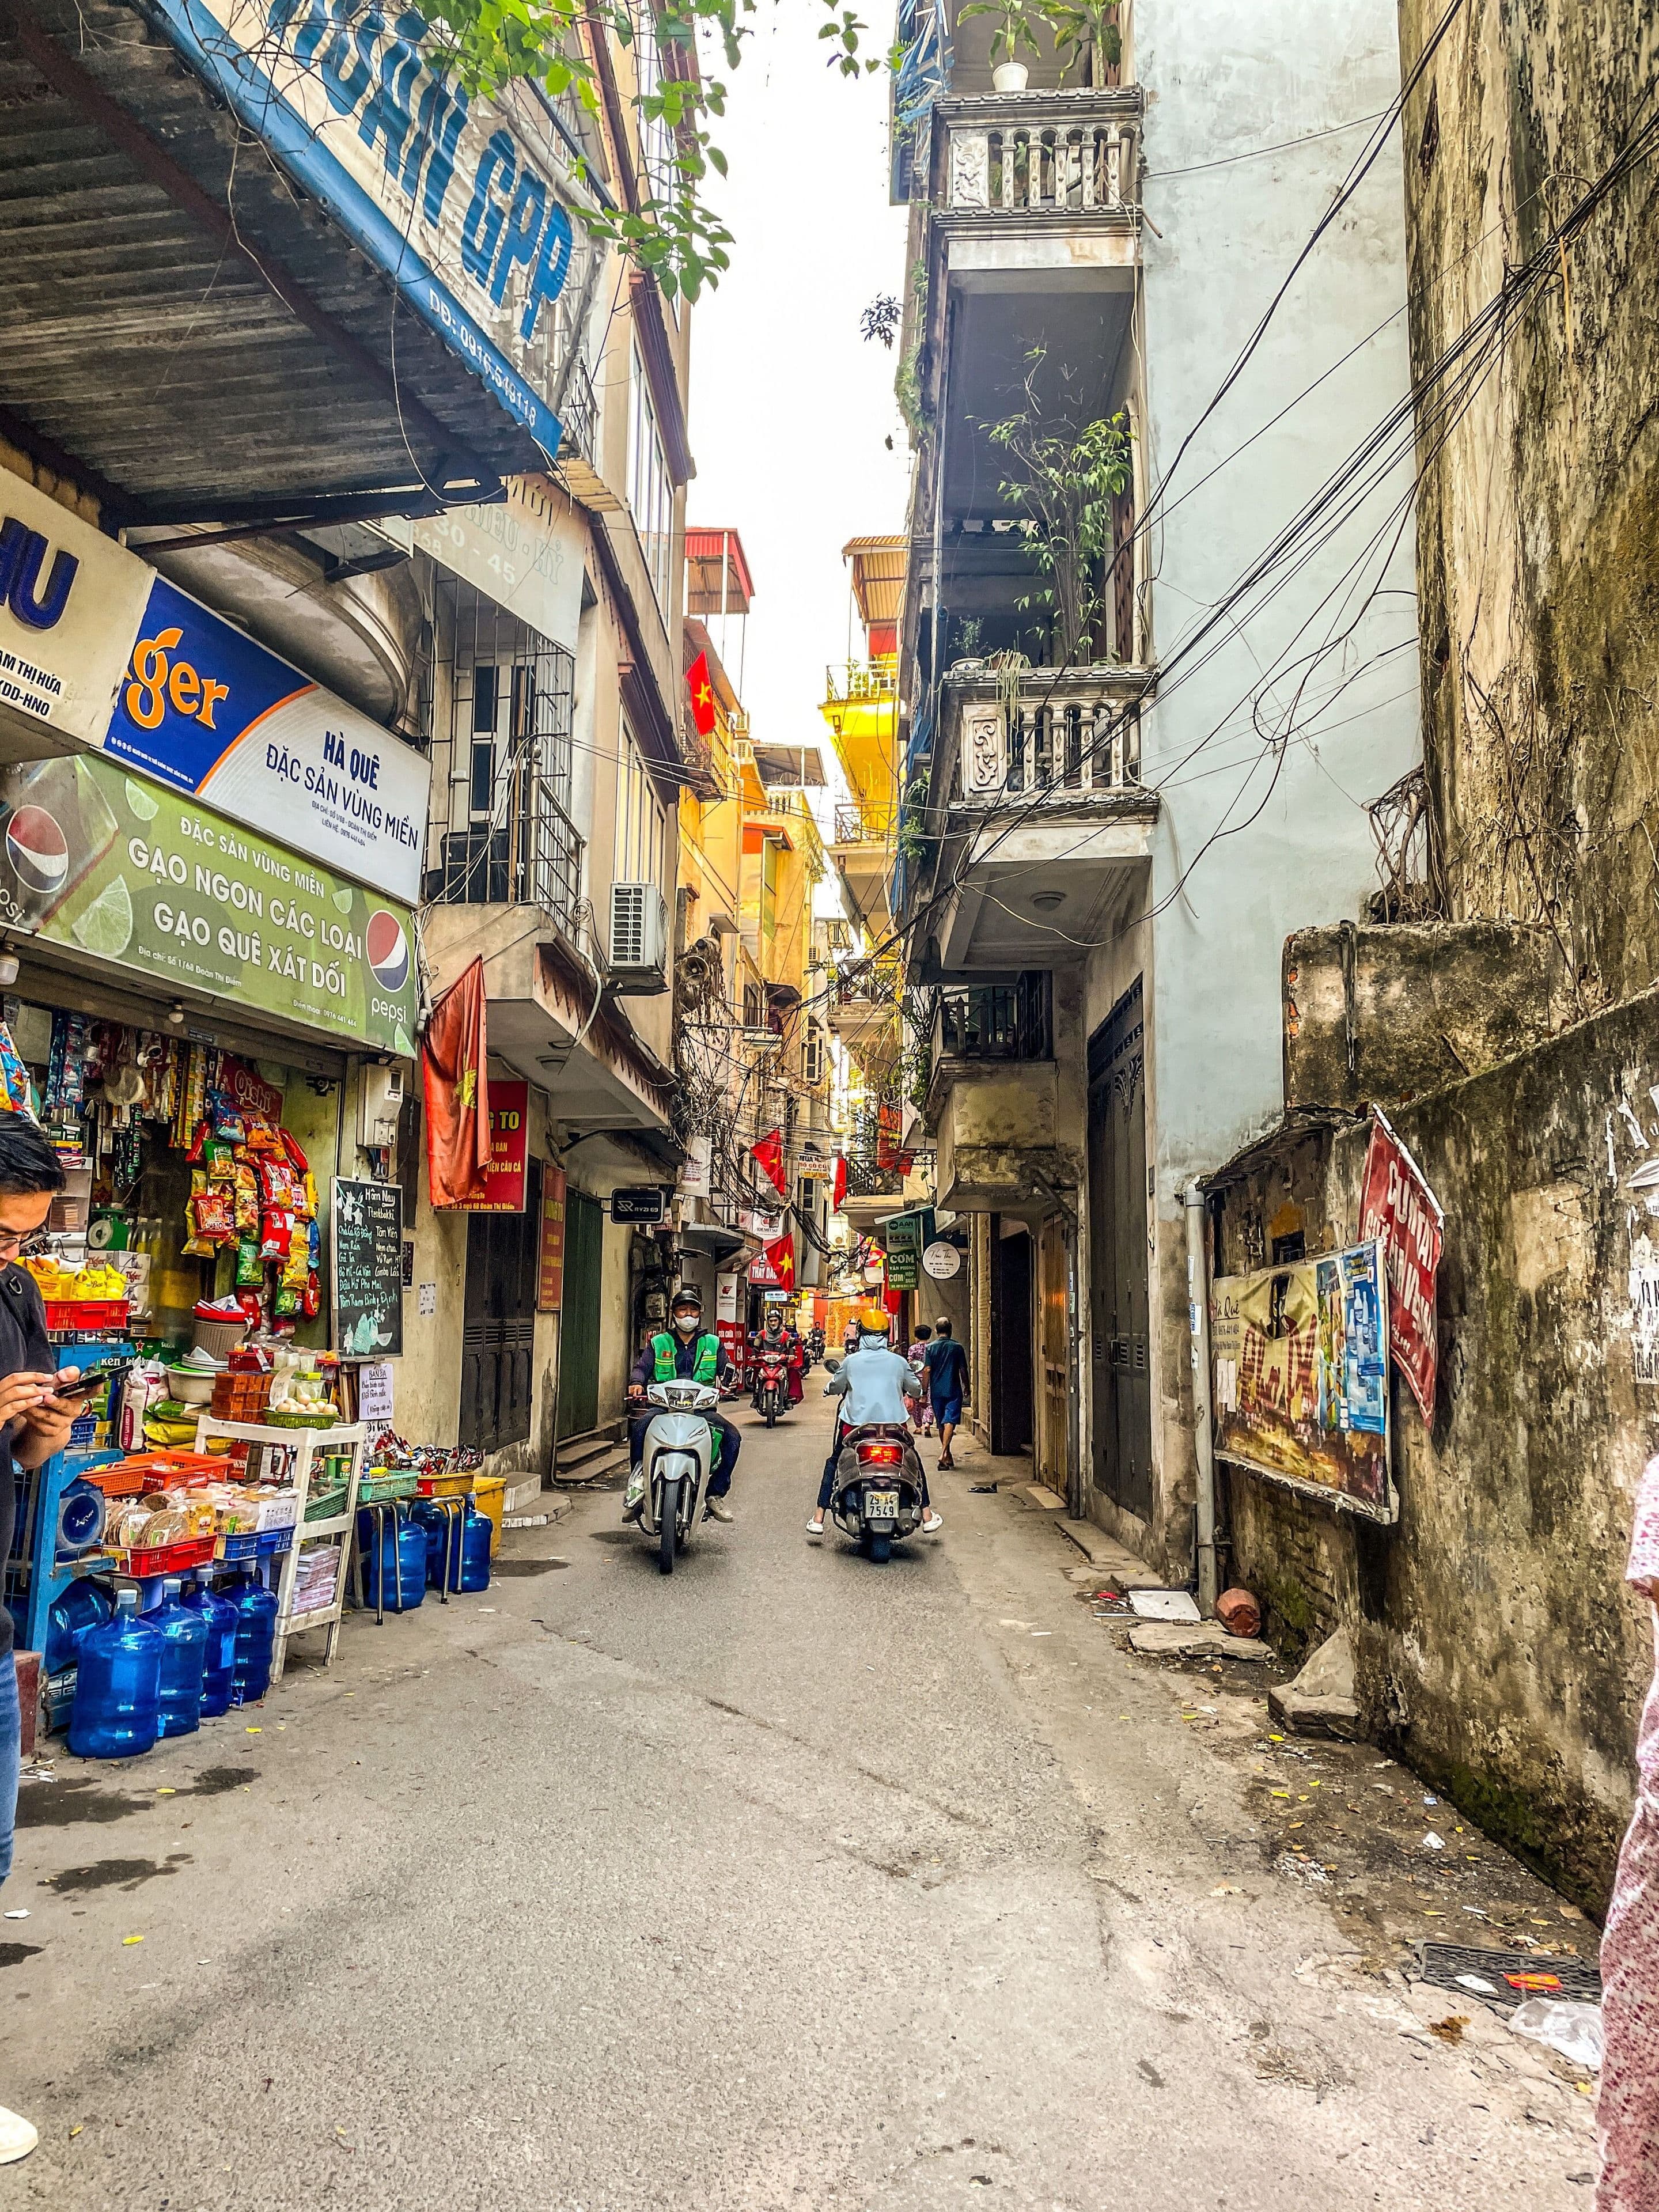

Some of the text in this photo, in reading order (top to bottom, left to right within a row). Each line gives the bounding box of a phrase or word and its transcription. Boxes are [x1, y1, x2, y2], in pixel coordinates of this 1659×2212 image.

[461, 129, 573, 343] GPP
[126, 628, 230, 729] ger
[323, 730, 380, 791] HÀ QUÊ
[266, 743, 419, 850] ĐẶC SẢN VÙNG MIỀN
[180, 816, 324, 899] ĐẶC SẢN VÙNG MIỀN
[128, 837, 362, 963] GẠO NGON CÁC LOẠI
[154, 902, 346, 997] GẠO QUÊ XÁT DỐI
[323, 1009, 336, 1019] 0976
[338, 1015, 346, 1023] 441
[372, 997, 406, 1023] pepsi
[235, 1070, 270, 1113] Oishi
[499, 1111, 520, 1130] TO
[513, 1160, 521, 1172] CÁ
[365, 1188, 395, 1207] Hôm Nay
[889, 1253, 915, 1264] CƠM
[126, 1271, 141, 1282] Tiger
[752, 1266, 765, 1278] THAY
[101, 1358, 120, 1366] ken
[870, 1506, 894, 1516] 7549
